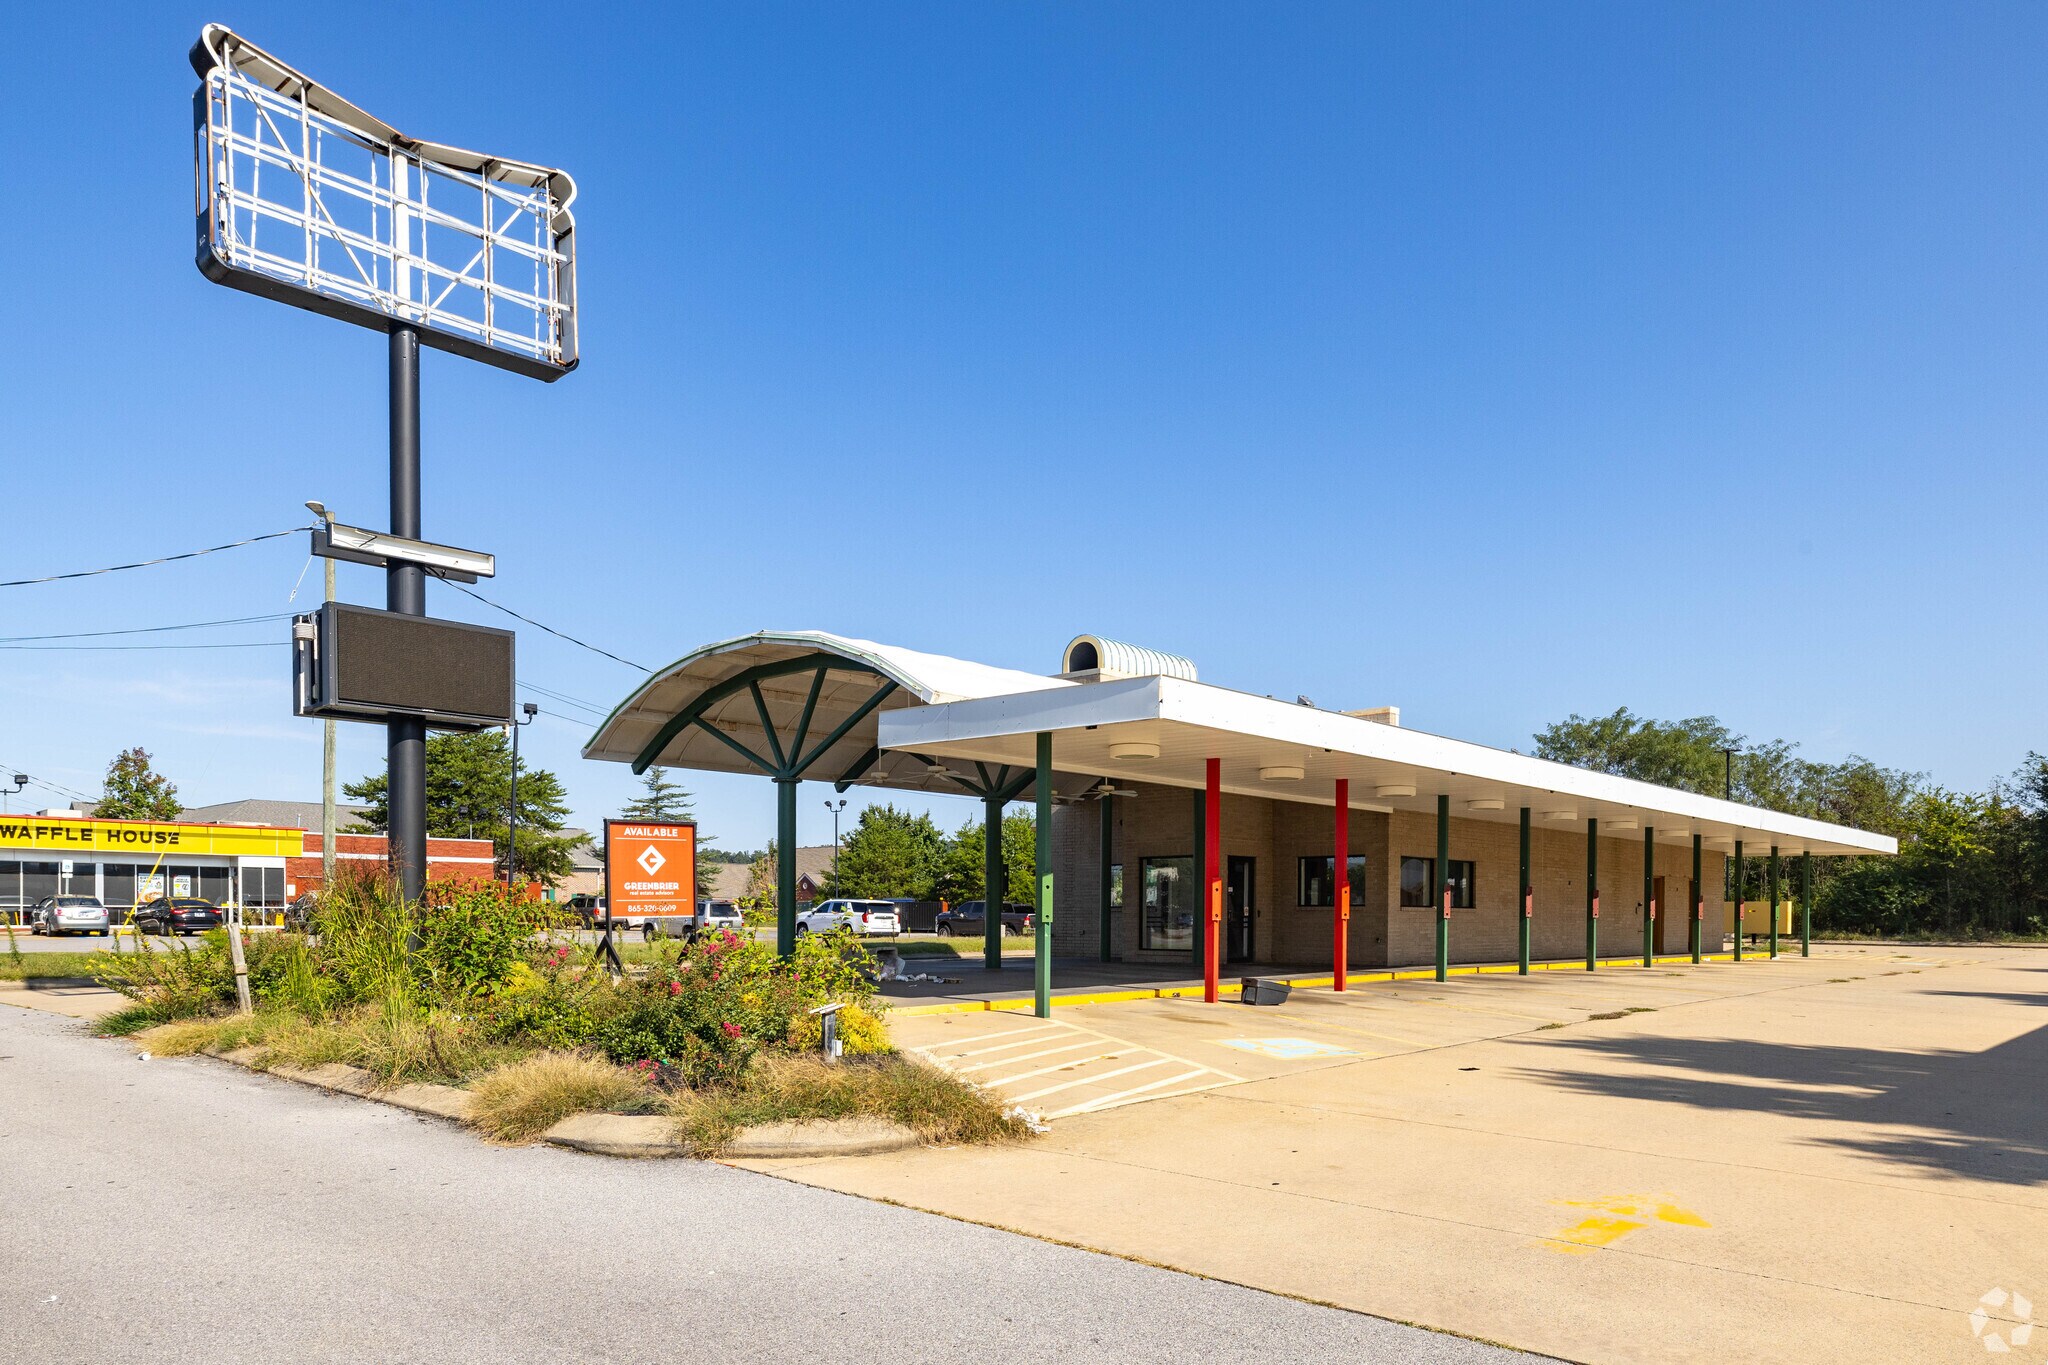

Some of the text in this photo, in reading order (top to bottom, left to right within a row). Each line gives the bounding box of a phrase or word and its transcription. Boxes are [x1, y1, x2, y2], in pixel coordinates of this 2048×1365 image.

[0, 825, 180, 844] WAFFLE HOUSE
[624, 827, 678, 836] AVAILABLE
[624, 882, 679, 890] GREENBRIER
[627, 904, 676, 912] 865-320-0609
